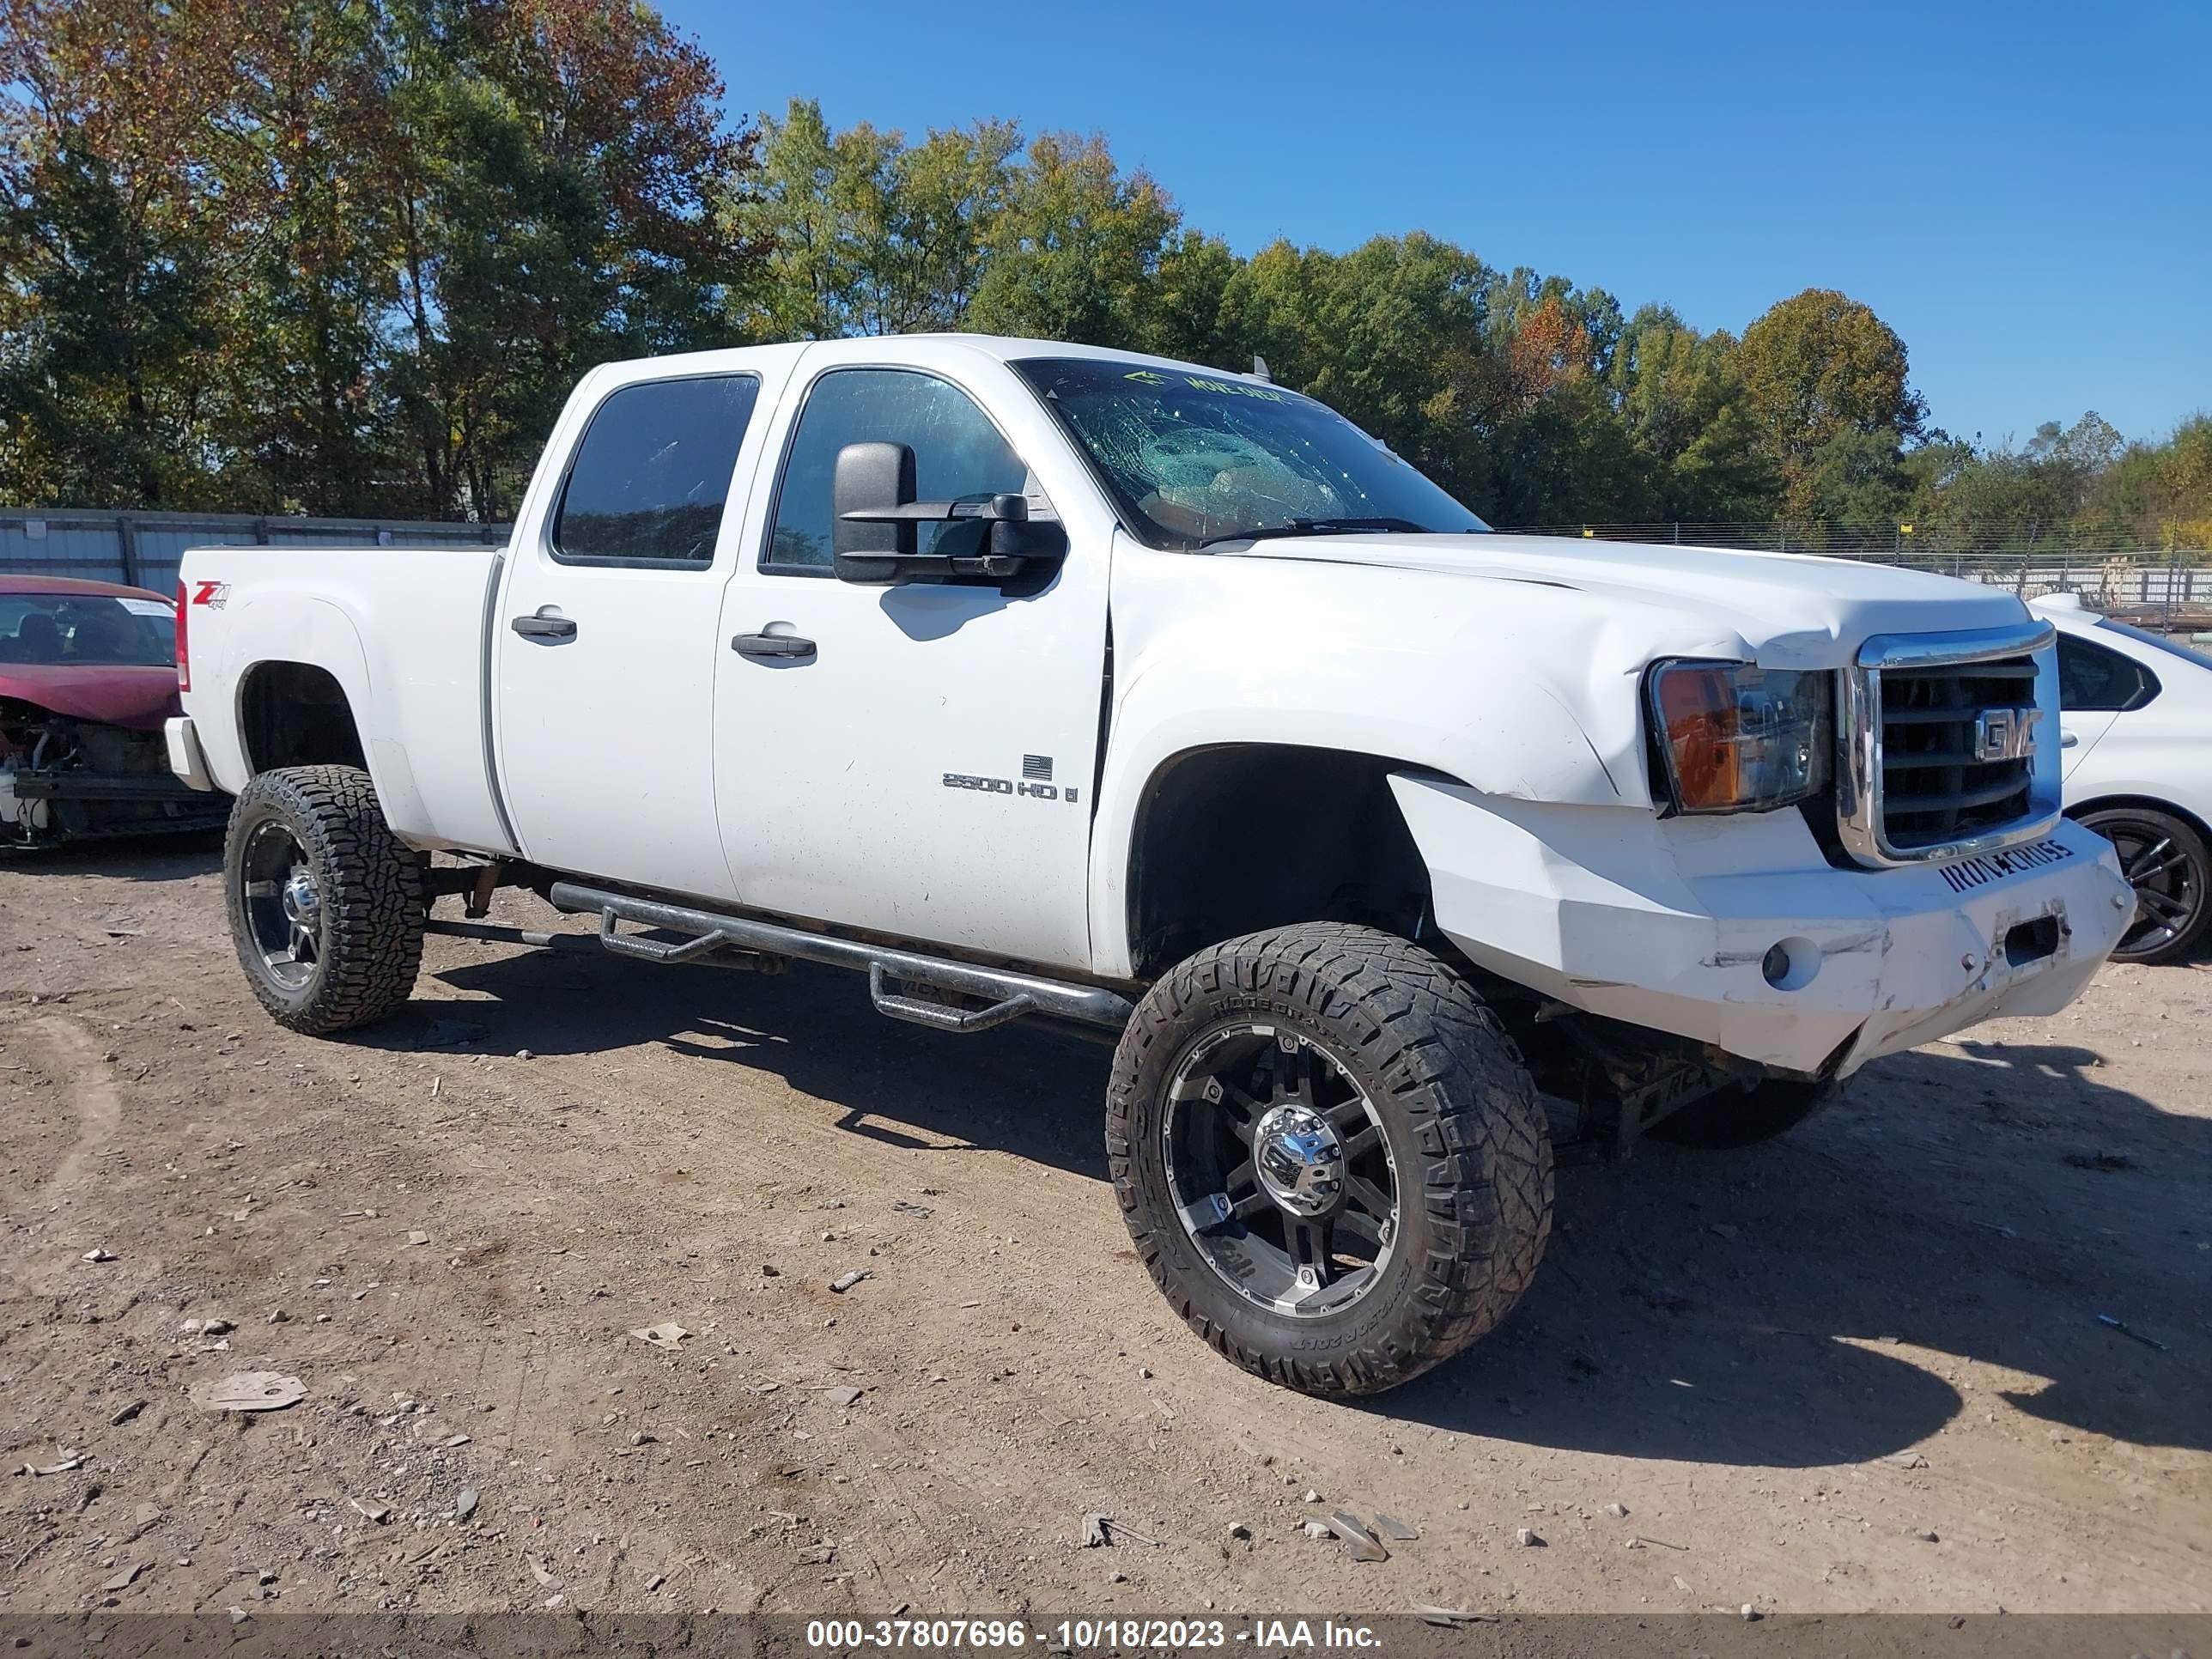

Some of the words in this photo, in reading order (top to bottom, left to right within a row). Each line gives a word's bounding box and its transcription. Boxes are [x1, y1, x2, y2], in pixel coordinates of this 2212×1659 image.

[1183, 376, 1243, 394] MOVE
[192, 580, 232, 605] Z71
[1977, 708, 2045, 763] GMC
[943, 773, 1013, 795] 2500
[1018, 781, 1058, 800] HD
[1939, 853, 2003, 894] IRON
[2006, 839, 2075, 872] CROSS
